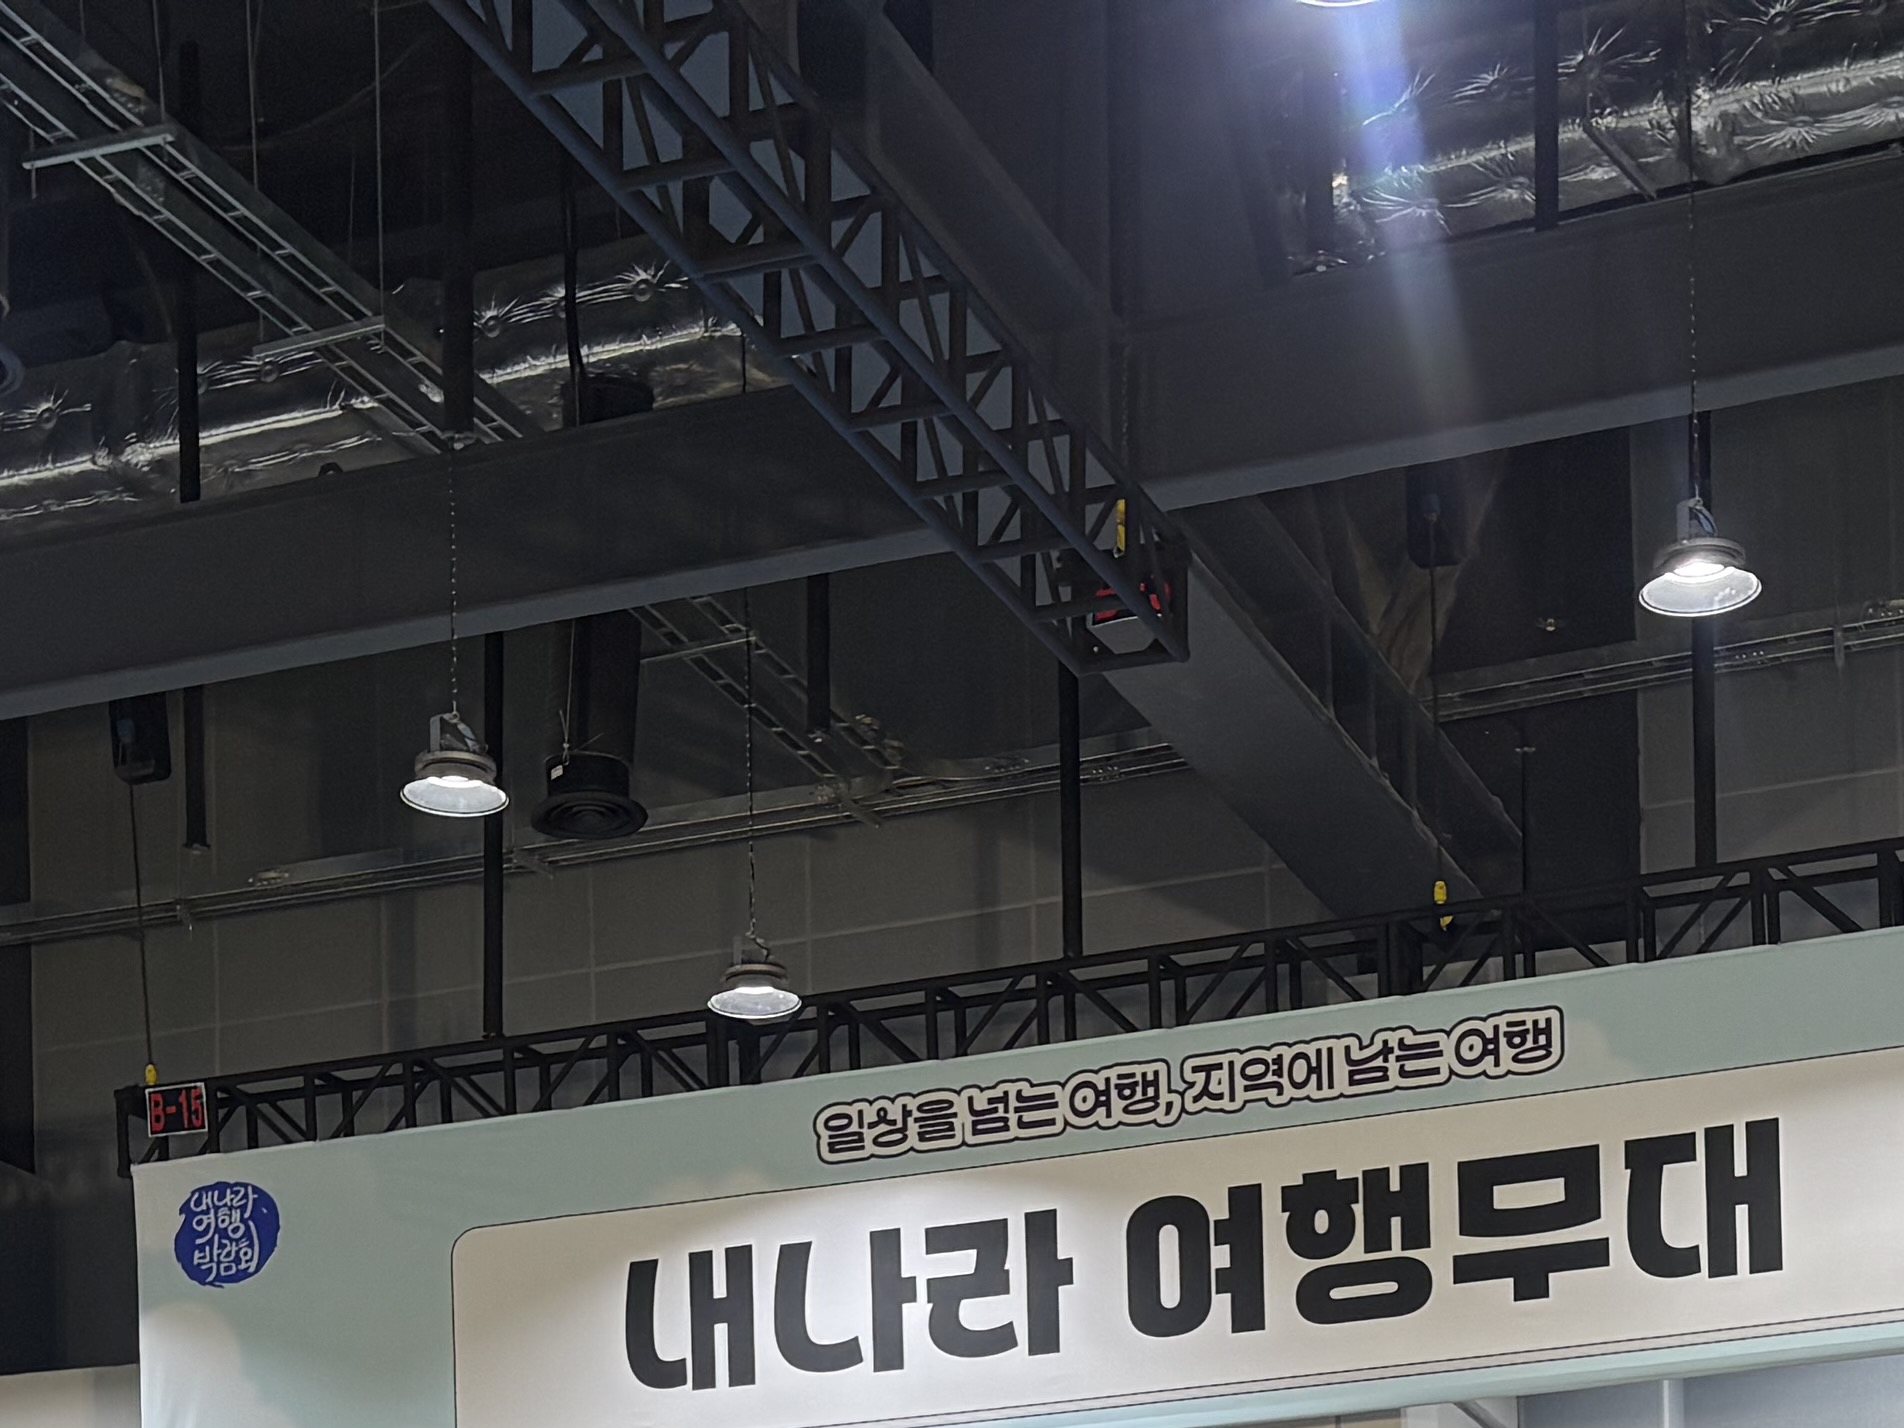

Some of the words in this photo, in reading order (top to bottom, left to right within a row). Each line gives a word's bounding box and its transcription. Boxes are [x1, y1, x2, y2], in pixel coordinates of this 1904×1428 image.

[150, 1089, 203, 1132] B-15
[822, 1100, 958, 1154] 일상을
[966, 1086, 1059, 1137] 넘는
[1067, 1068, 1176, 1129] 여행,
[1189, 1050, 1335, 1109] 지역에
[1344, 1033, 1444, 1087] 남는
[1455, 1015, 1554, 1071] 여행
[190, 1185, 258, 1218] 내나라
[193, 1207, 245, 1245] 여행
[193, 1221, 261, 1283] 박람회
[624, 1200, 1075, 1394] 내나라
[1128, 1118, 1780, 1343] 여행무대
